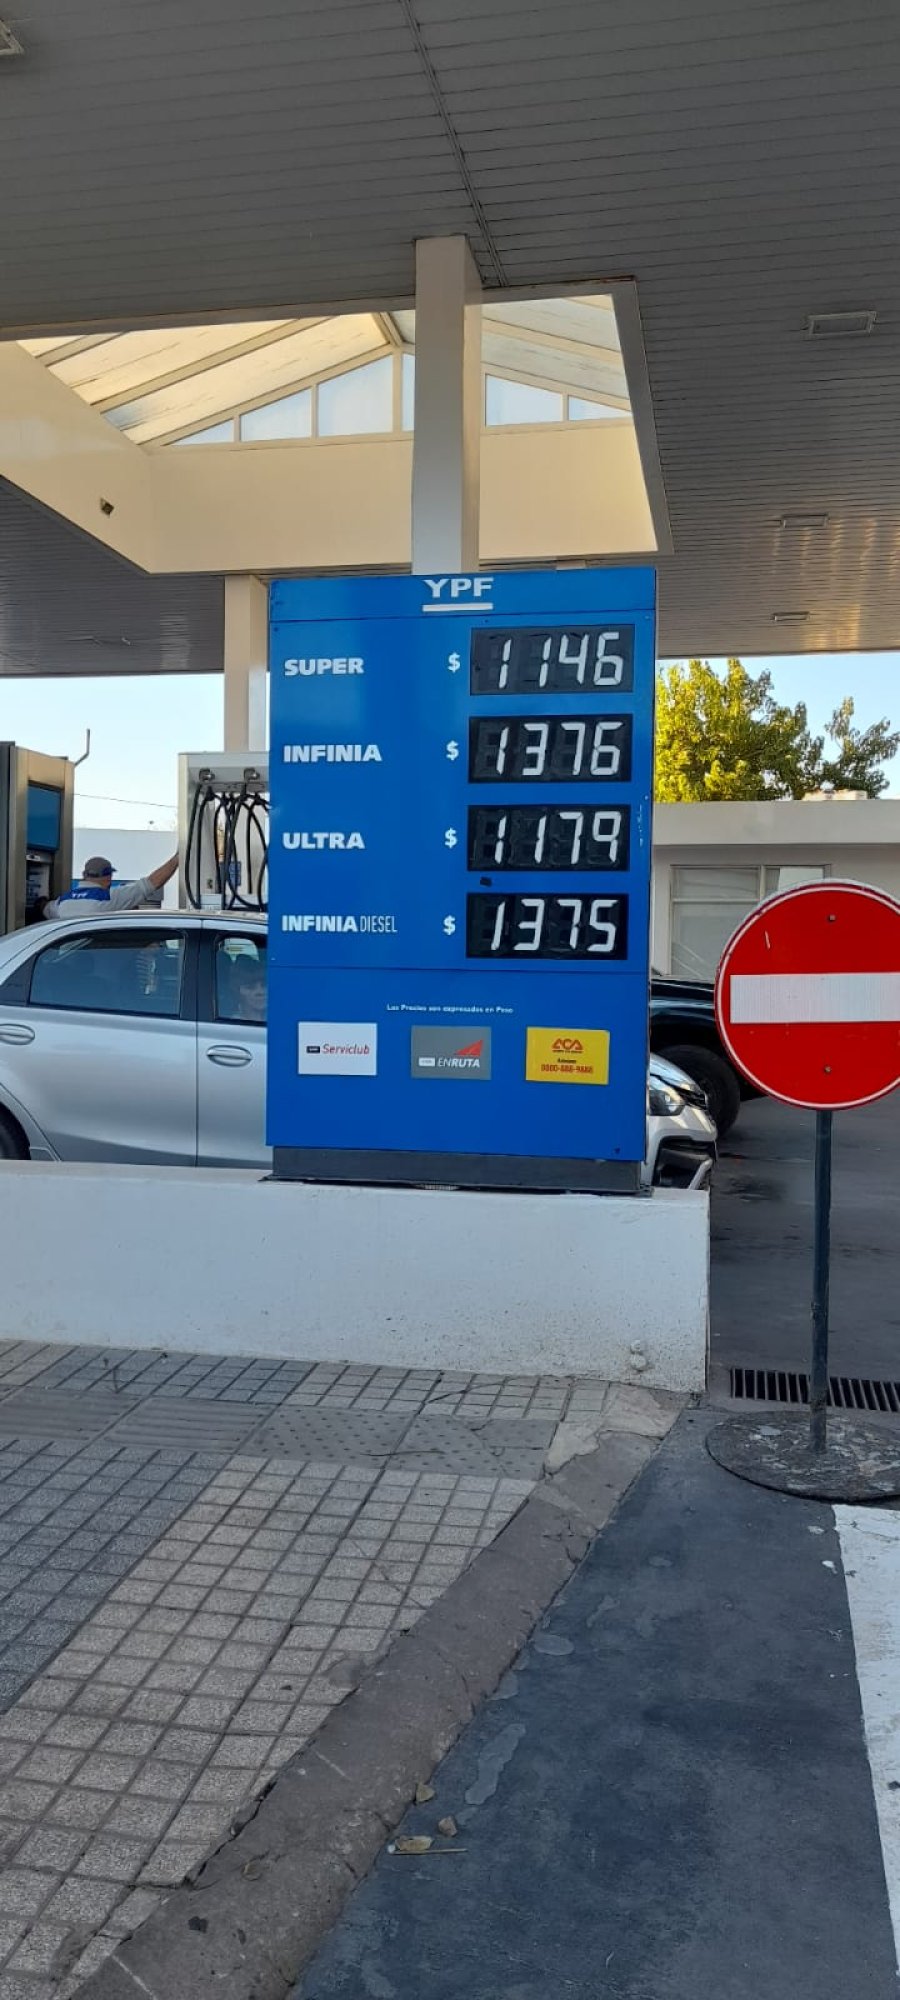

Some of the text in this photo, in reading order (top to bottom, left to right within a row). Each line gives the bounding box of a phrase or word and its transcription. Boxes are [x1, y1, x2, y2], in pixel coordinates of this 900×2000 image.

[423, 577, 494, 599] YPF
[284, 631, 624, 689] SUPER $ 1146
[283, 721, 623, 776] INFINIA $ 1376
[283, 810, 622, 864] ULTRA $ 1179
[282, 898, 618, 952] INFINIA DIESEL $ 1375
[322, 1043, 370, 1055] Serviclub
[551, 1038, 584, 1051] ACA
